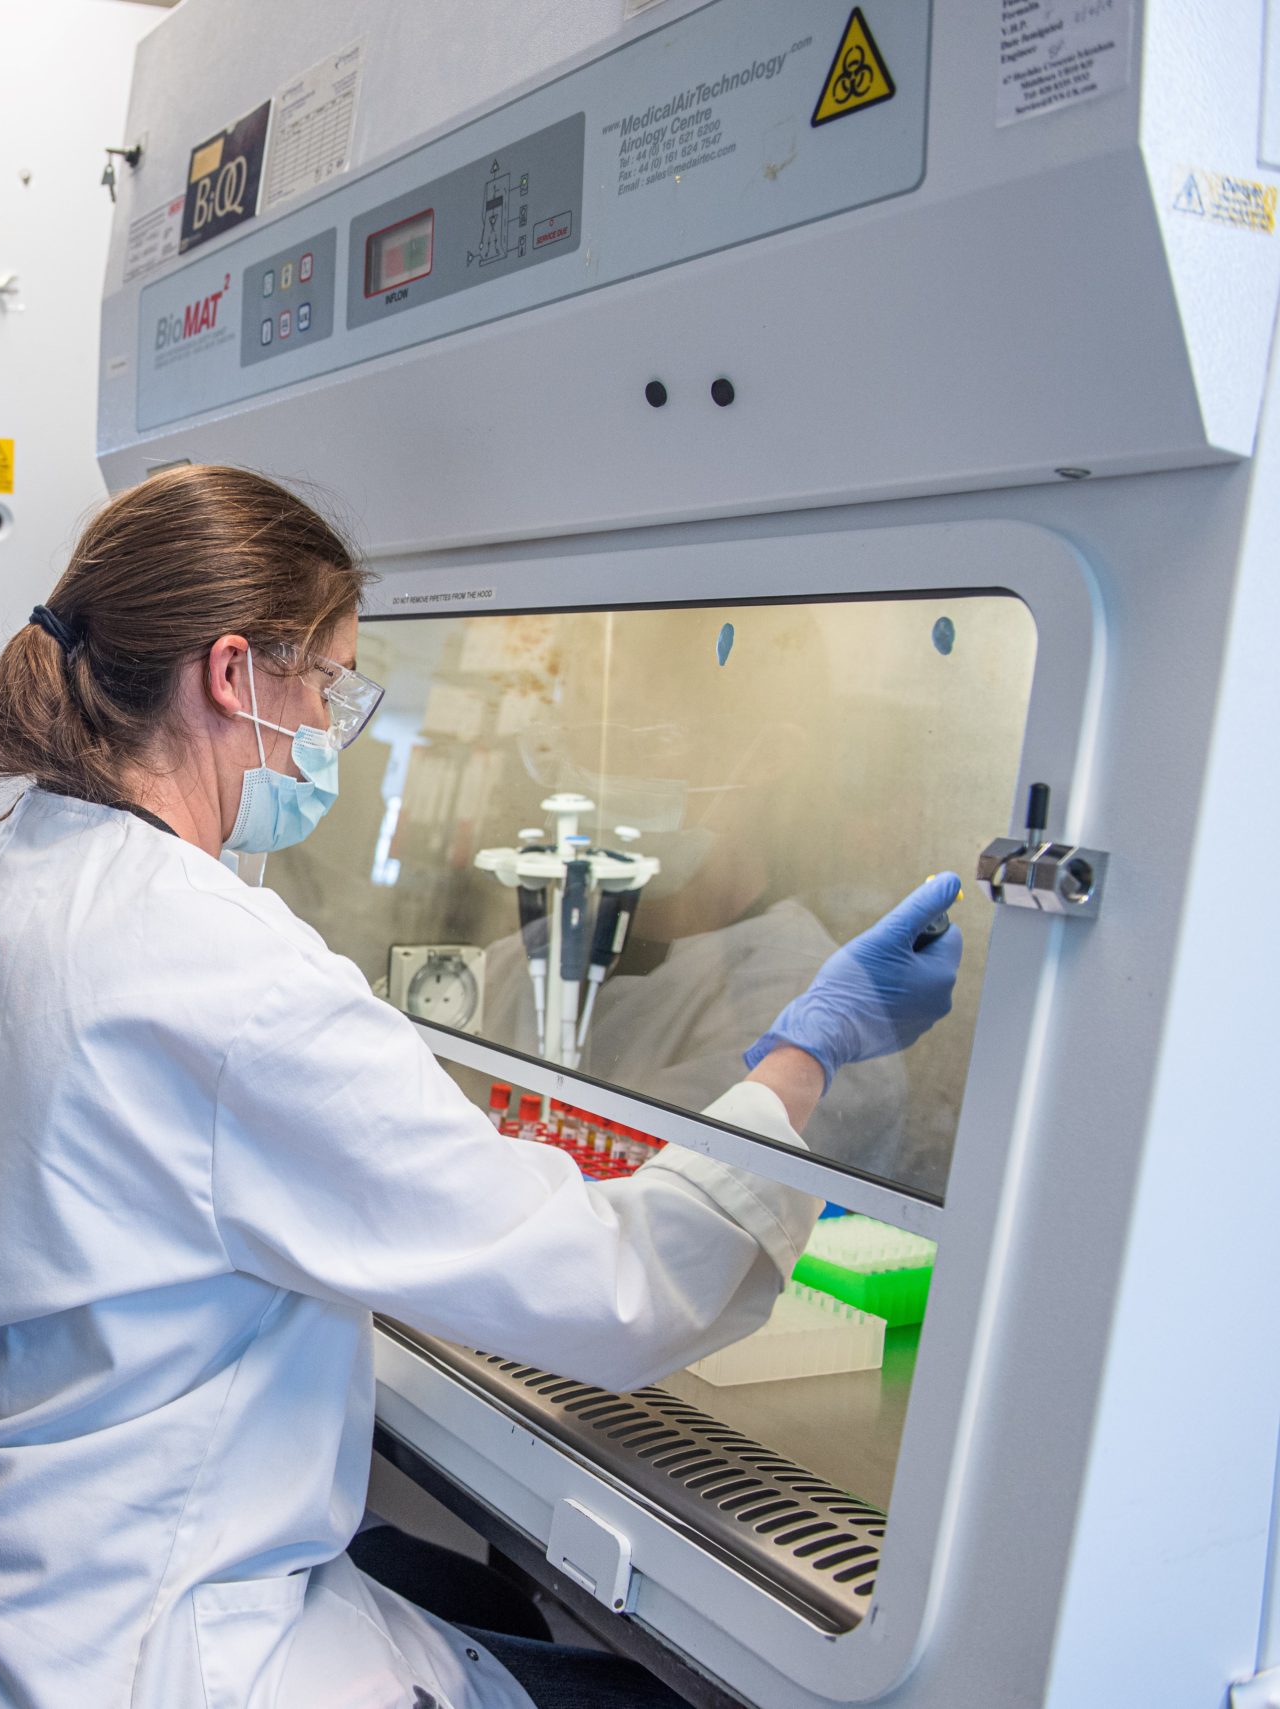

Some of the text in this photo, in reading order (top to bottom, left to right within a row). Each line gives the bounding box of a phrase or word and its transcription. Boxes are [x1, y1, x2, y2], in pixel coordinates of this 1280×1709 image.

[619, 107, 712, 157] Airology Centre
[636, 149, 647, 161] 44
[648, 143, 660, 159] (0)
[663, 138, 675, 152] 161
[679, 130, 694, 145] 621
[697, 120, 720, 137] 6200
[638, 163, 649, 174] 44
[650, 158, 661, 170] (0)
[664, 150, 678, 164] 161
[681, 142, 698, 157] 624
[701, 132, 722, 150] 7547
[385, 288, 408, 304] INFLOW
[400, 596, 409, 604] NOT
[410, 595, 428, 604] REMOVE
[429, 593, 450, 602] PIPETTES
[451, 592, 466, 600] FROM
[467, 591, 476, 599] THE
[477, 589, 493, 598] HOOD
